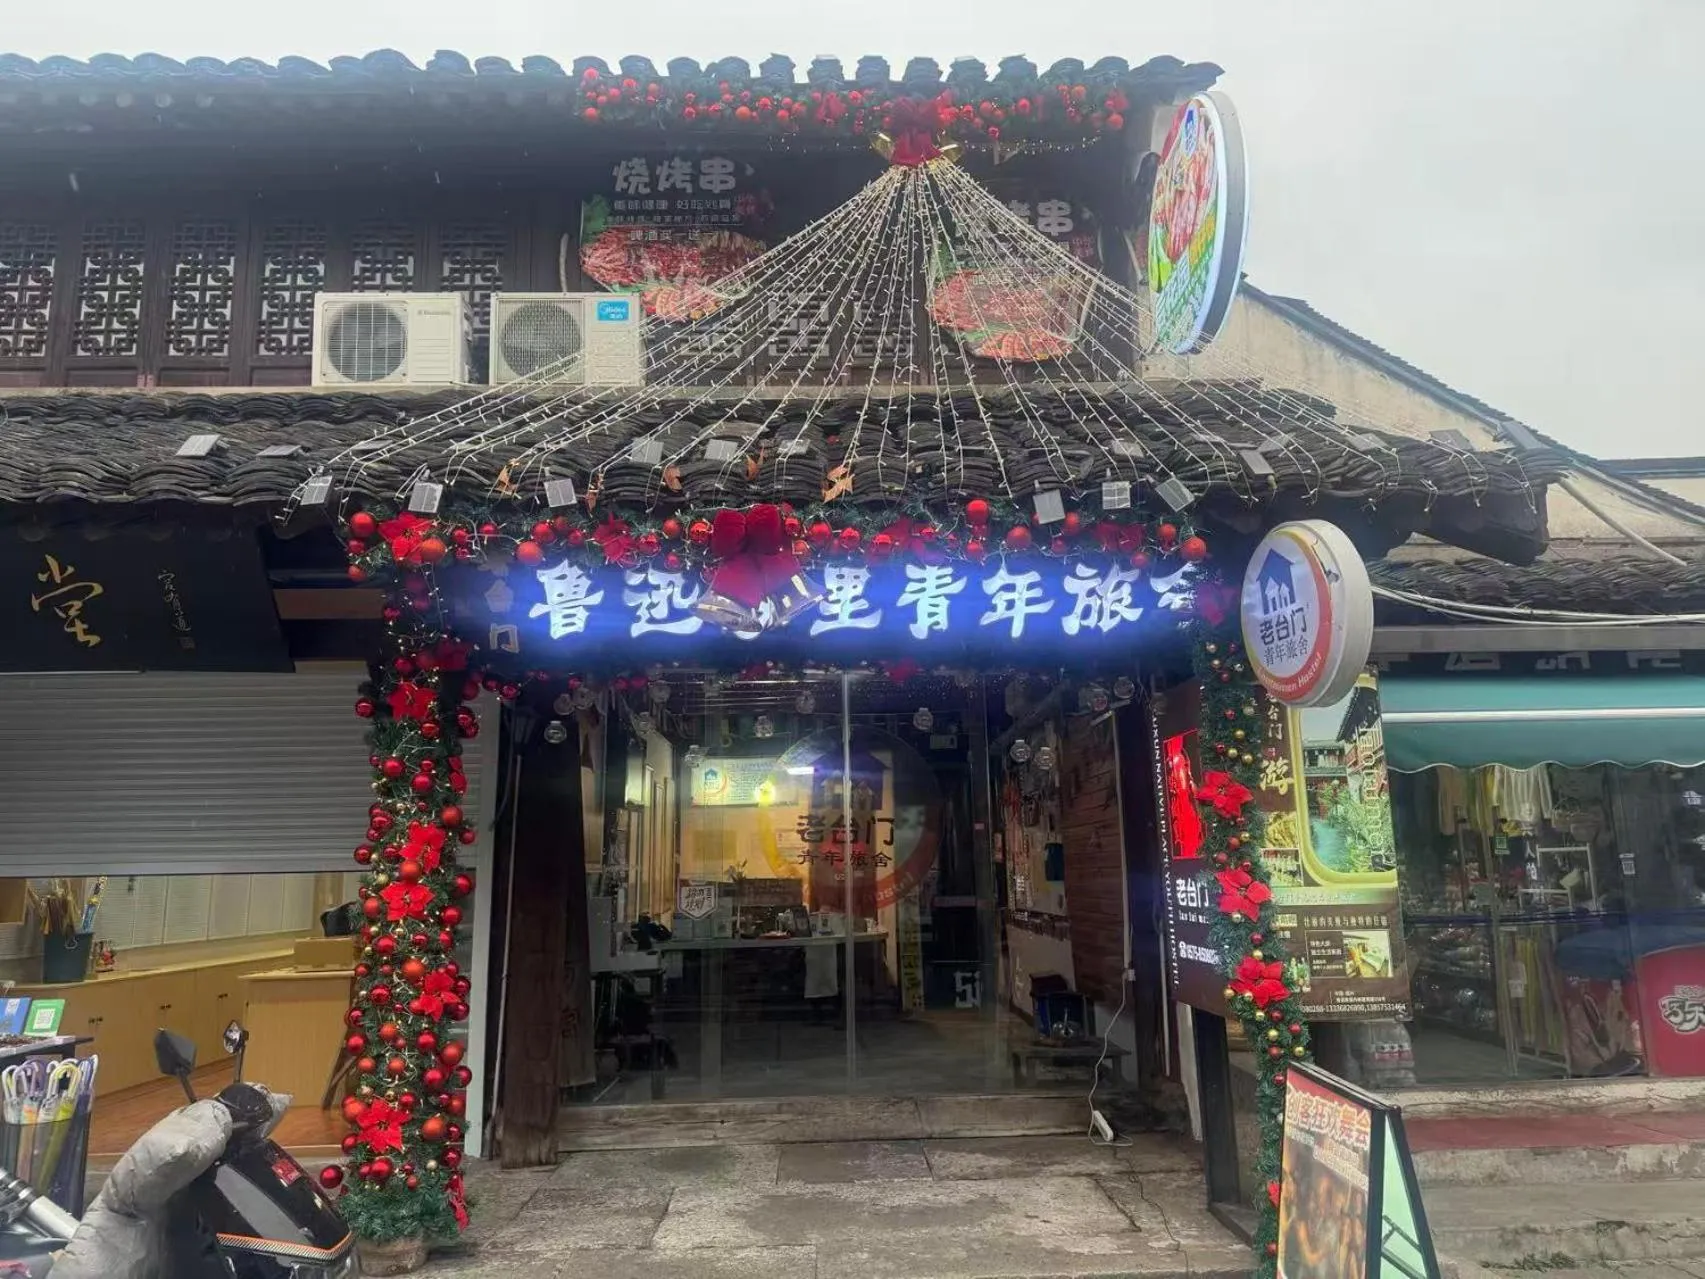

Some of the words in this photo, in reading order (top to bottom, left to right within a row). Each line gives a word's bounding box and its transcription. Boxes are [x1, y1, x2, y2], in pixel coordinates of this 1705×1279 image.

[612, 156, 737, 195] 烧烤串
[528, 558, 1199, 641] 鲁迅里青年旅
[1259, 607, 1307, 645] 老台门
[797, 814, 896, 846] 老台门
[1176, 877, 1209, 908] 老台门
